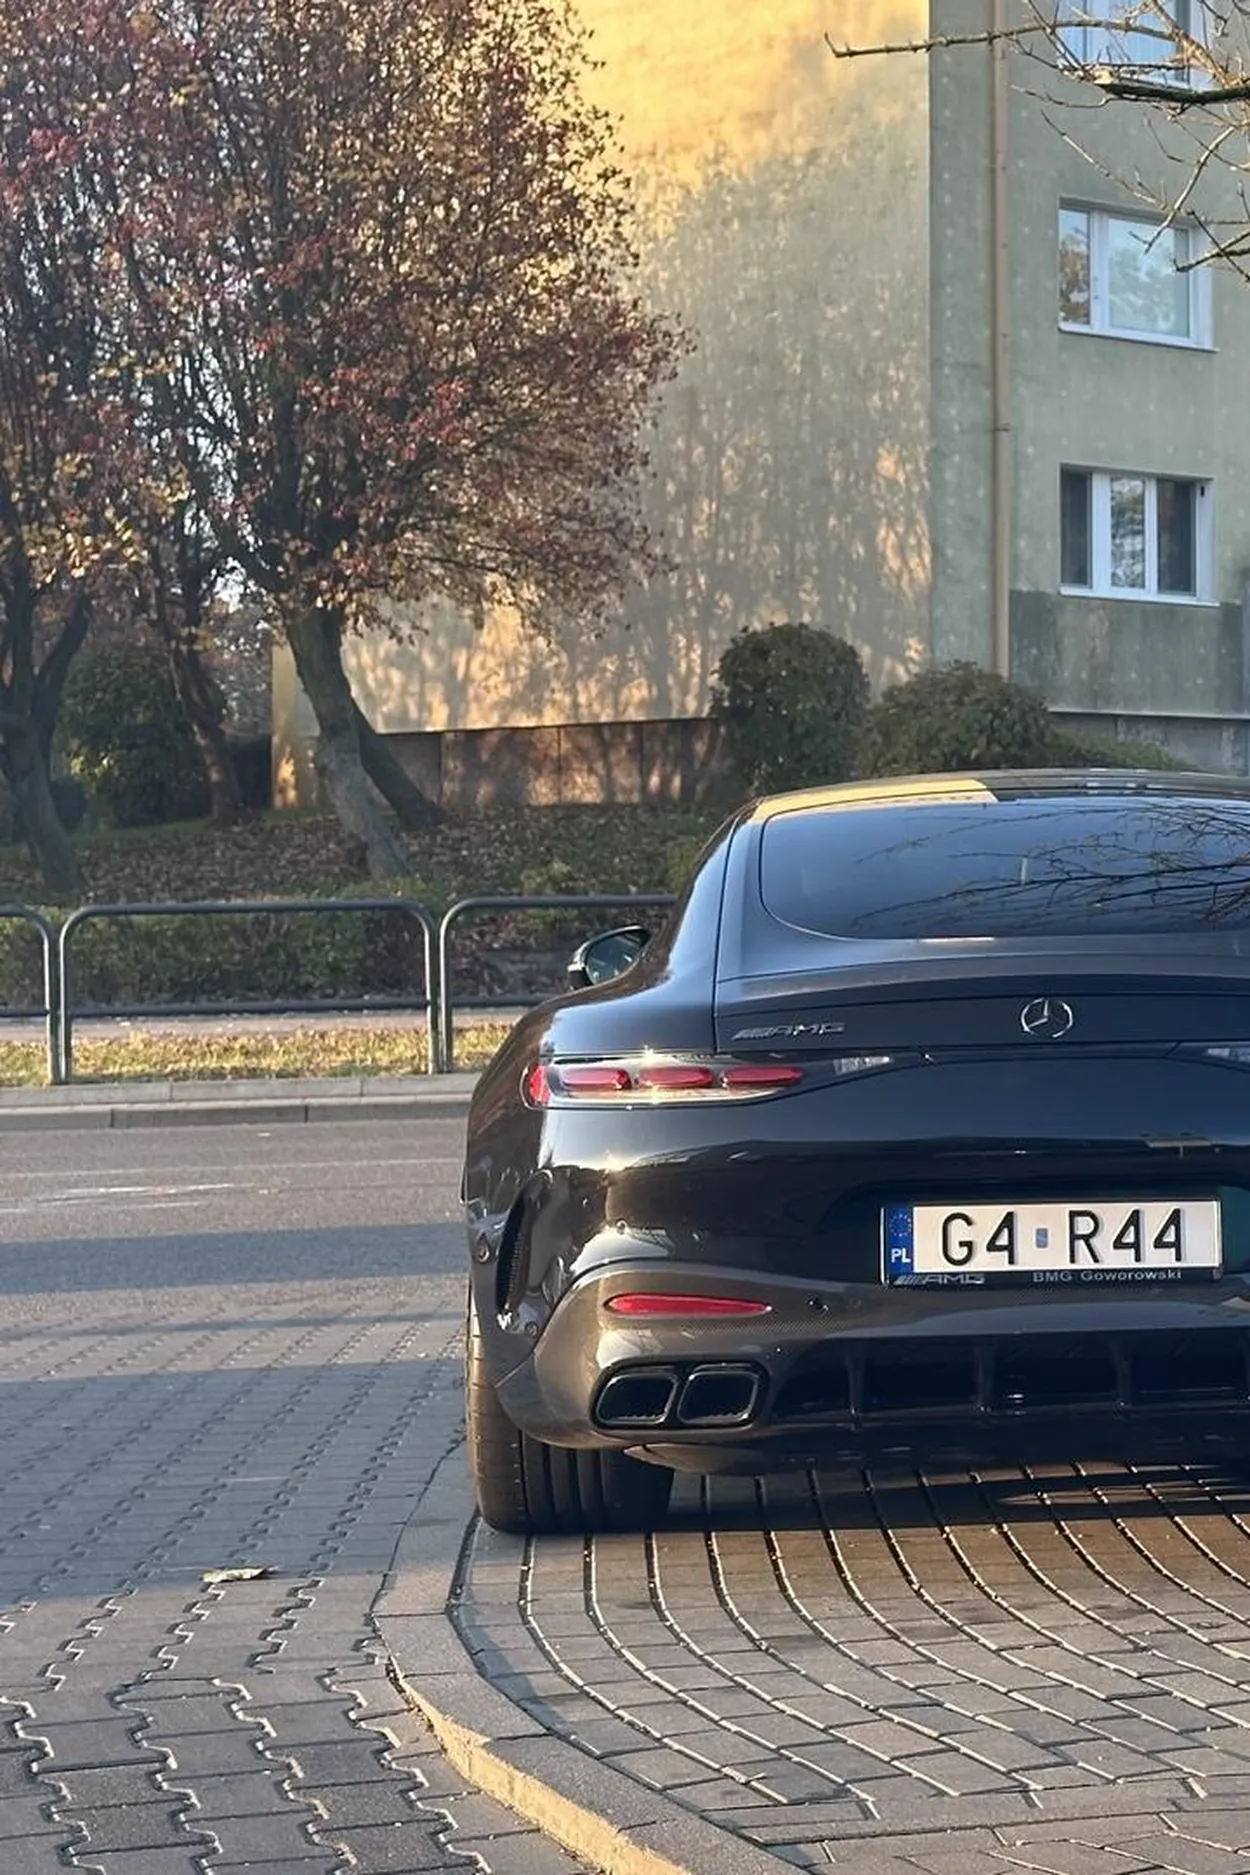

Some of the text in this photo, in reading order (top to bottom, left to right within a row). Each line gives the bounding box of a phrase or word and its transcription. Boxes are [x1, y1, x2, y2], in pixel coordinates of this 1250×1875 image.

[942, 1208, 1183, 1266] G4 R44
[891, 1248, 911, 1263] PL
[921, 1273, 986, 1285] AMG
[1033, 1269, 1182, 1283] BMG Goworowski
